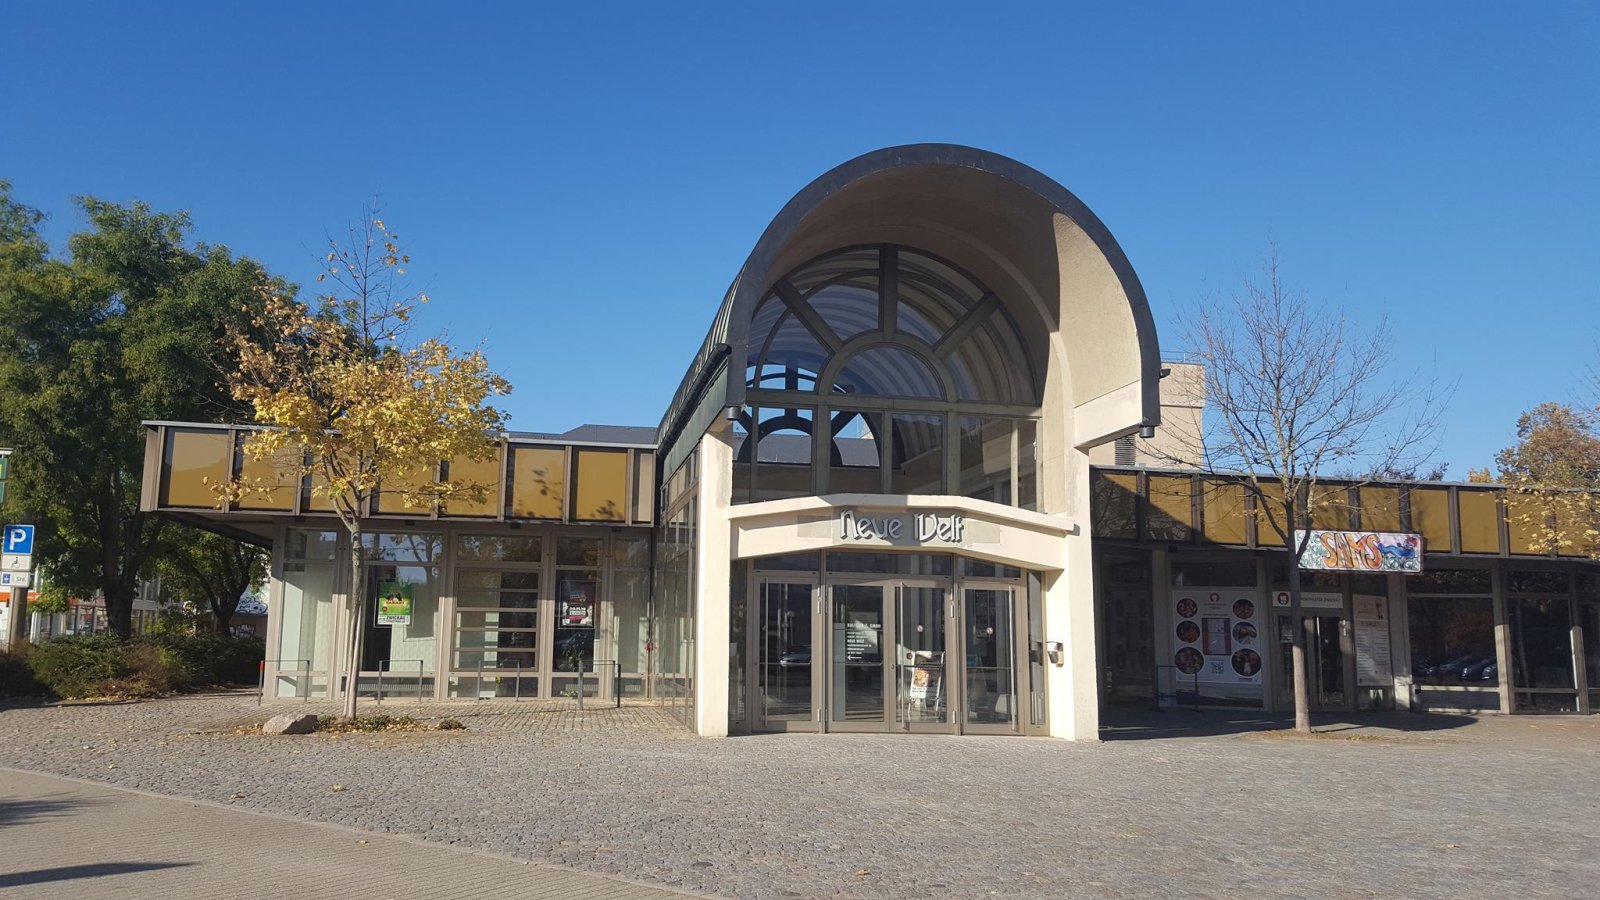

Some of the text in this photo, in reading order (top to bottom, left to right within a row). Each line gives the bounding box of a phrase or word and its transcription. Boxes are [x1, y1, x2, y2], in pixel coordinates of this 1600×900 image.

[9, 528, 27, 551] P
[840, 510, 964, 543] Neue Welt
[1319, 532, 1384, 569] SAMS
